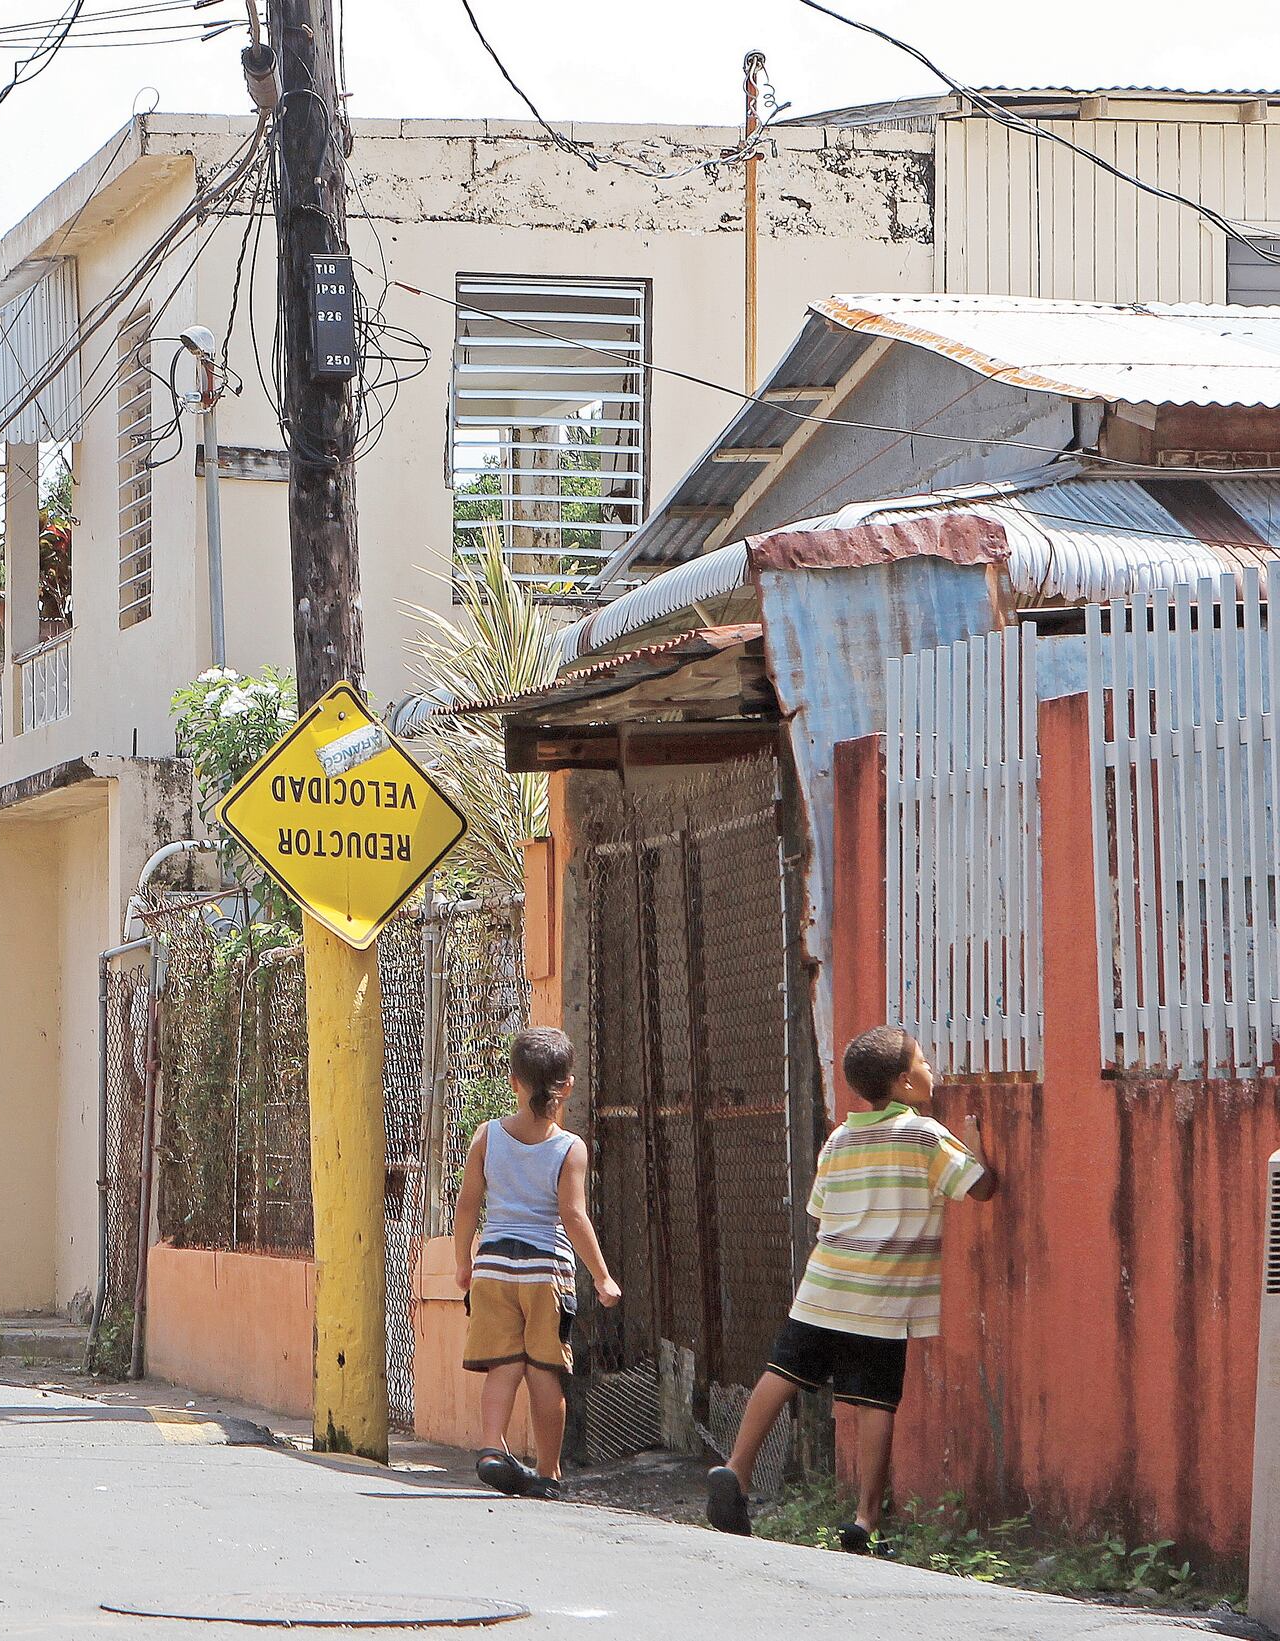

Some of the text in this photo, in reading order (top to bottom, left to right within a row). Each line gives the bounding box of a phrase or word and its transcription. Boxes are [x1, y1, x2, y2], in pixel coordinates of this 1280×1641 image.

[317, 311, 343, 322] 226
[326, 355, 351, 366] 250
[272, 775, 417, 810] VELOCIDAD
[278, 828, 412, 862] REDUCTOR
